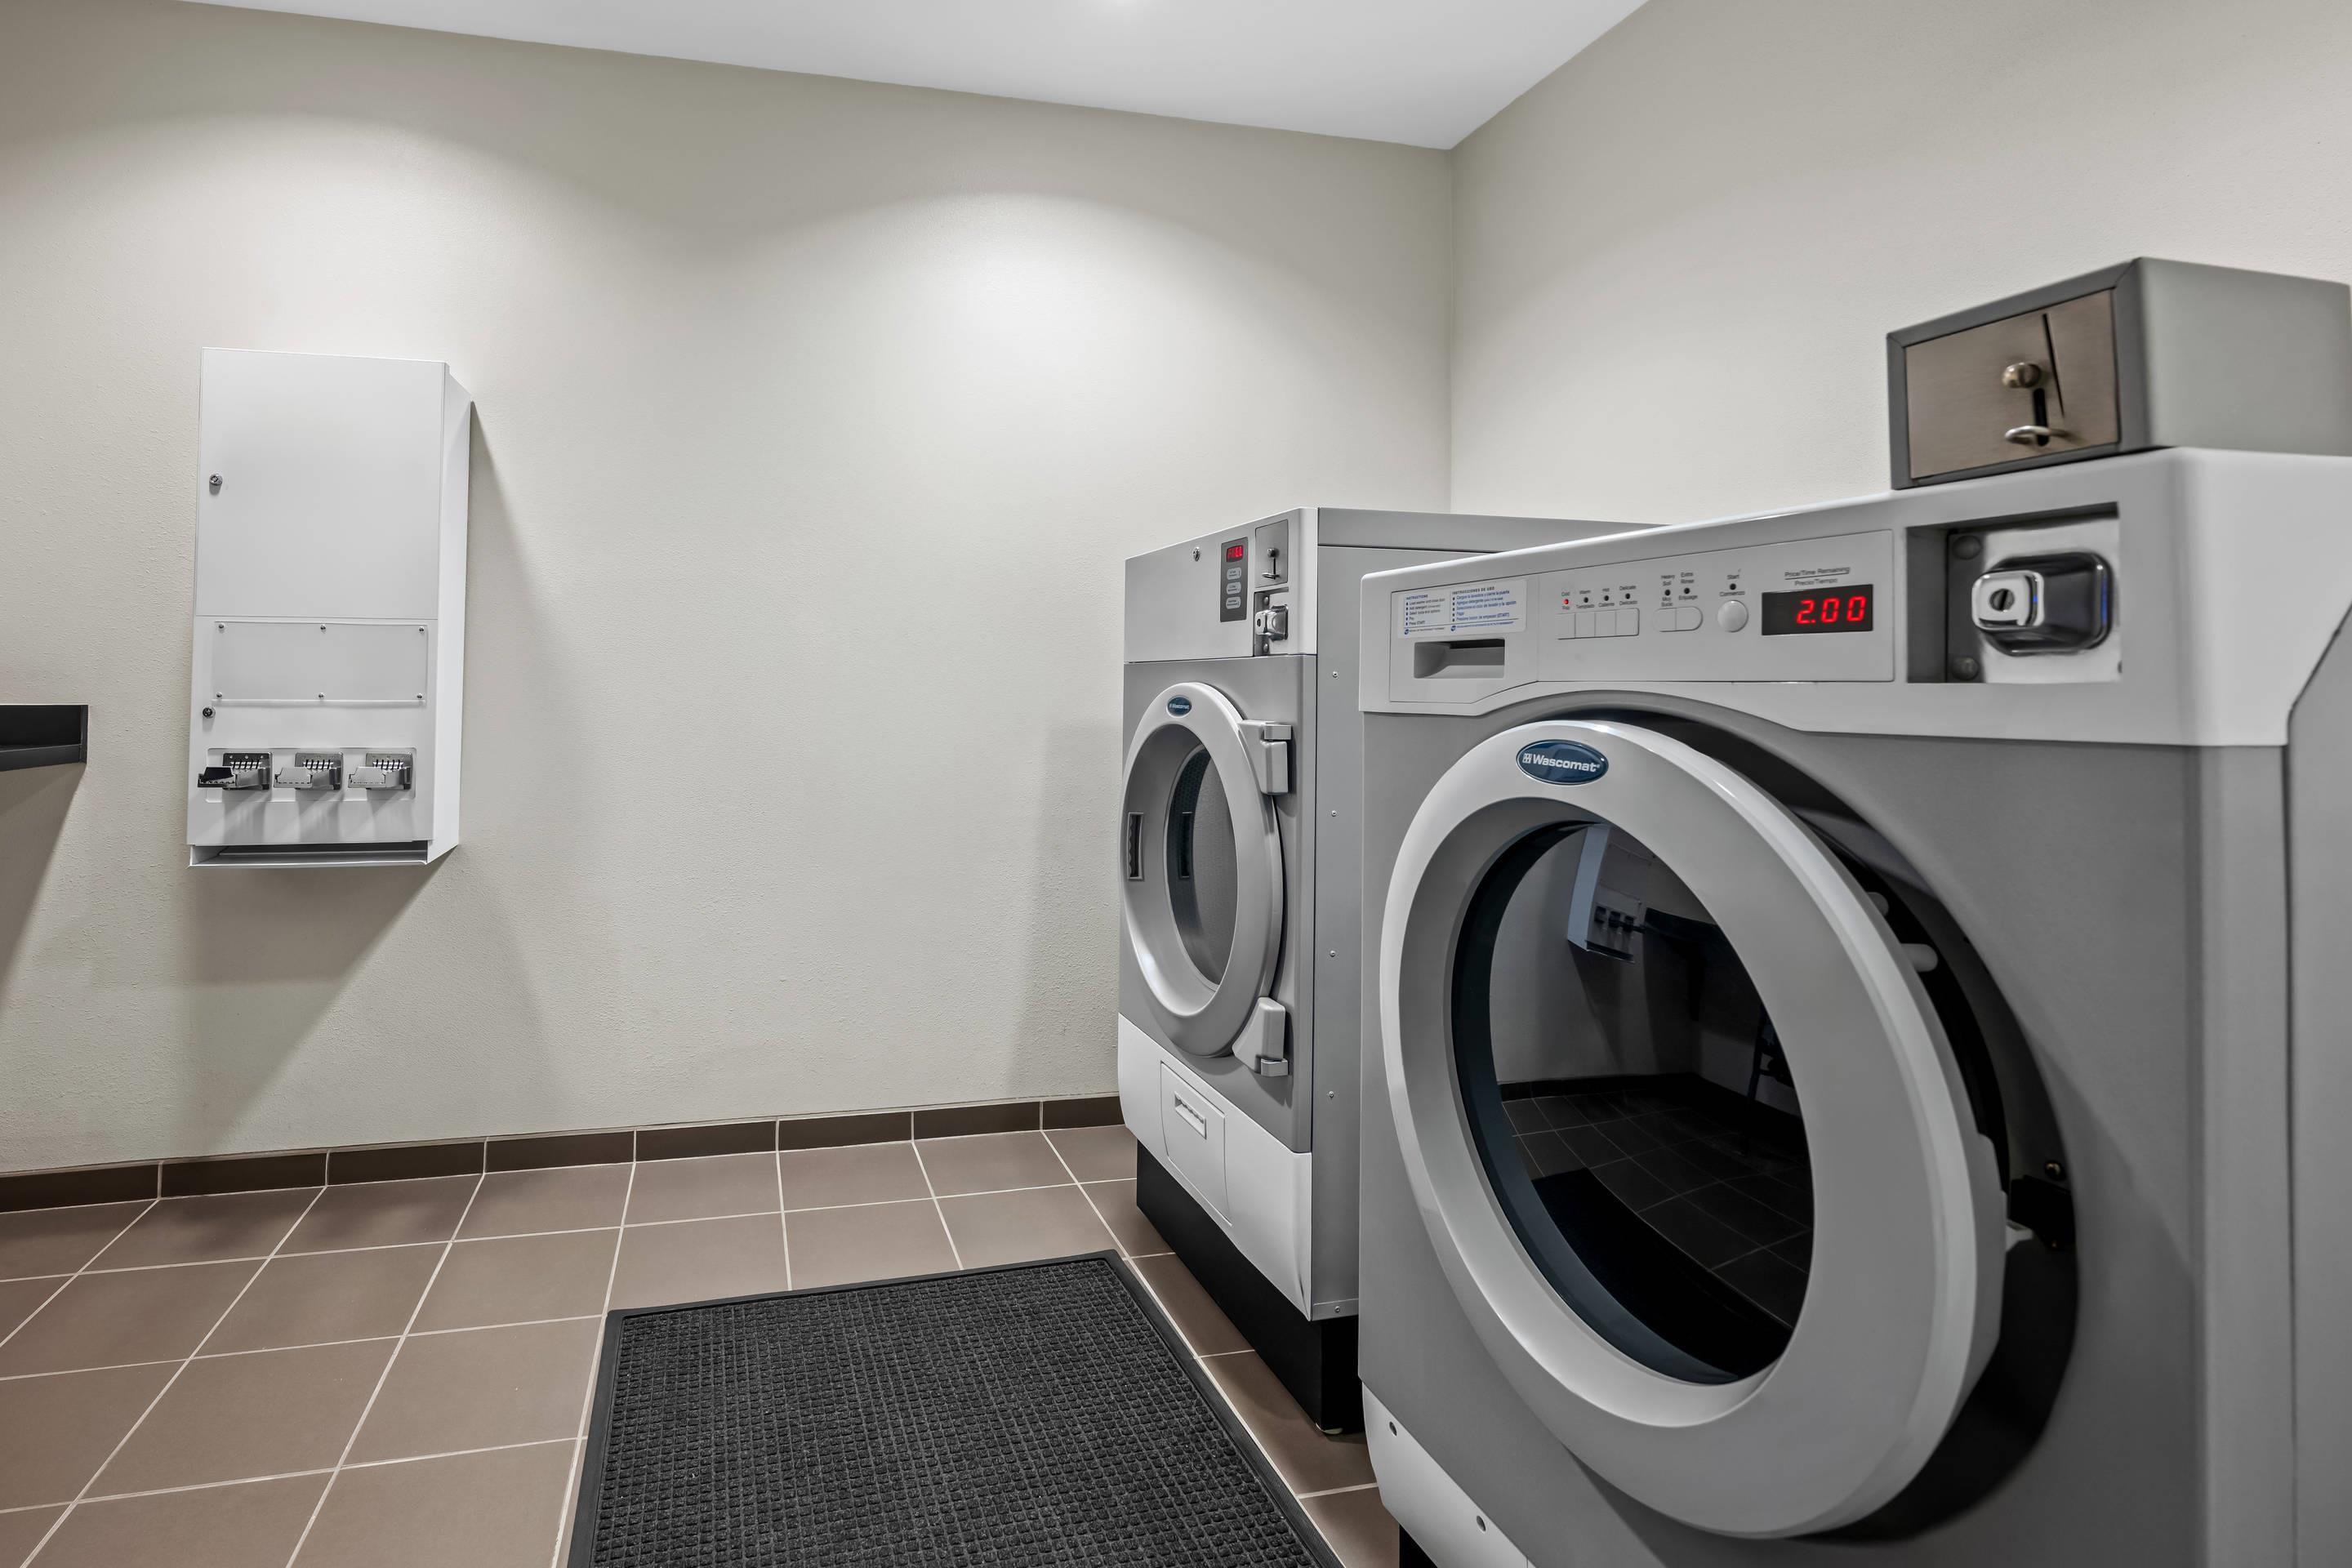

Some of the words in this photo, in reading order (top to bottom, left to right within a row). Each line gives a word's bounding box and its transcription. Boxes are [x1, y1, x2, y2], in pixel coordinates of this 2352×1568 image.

[1784, 569, 1815, 577] Price/Time
[1794, 578, 1838, 586] Precio/Tiempo
[1796, 595, 1866, 624] 2.00
[1533, 754, 1597, 772] Wascomat
